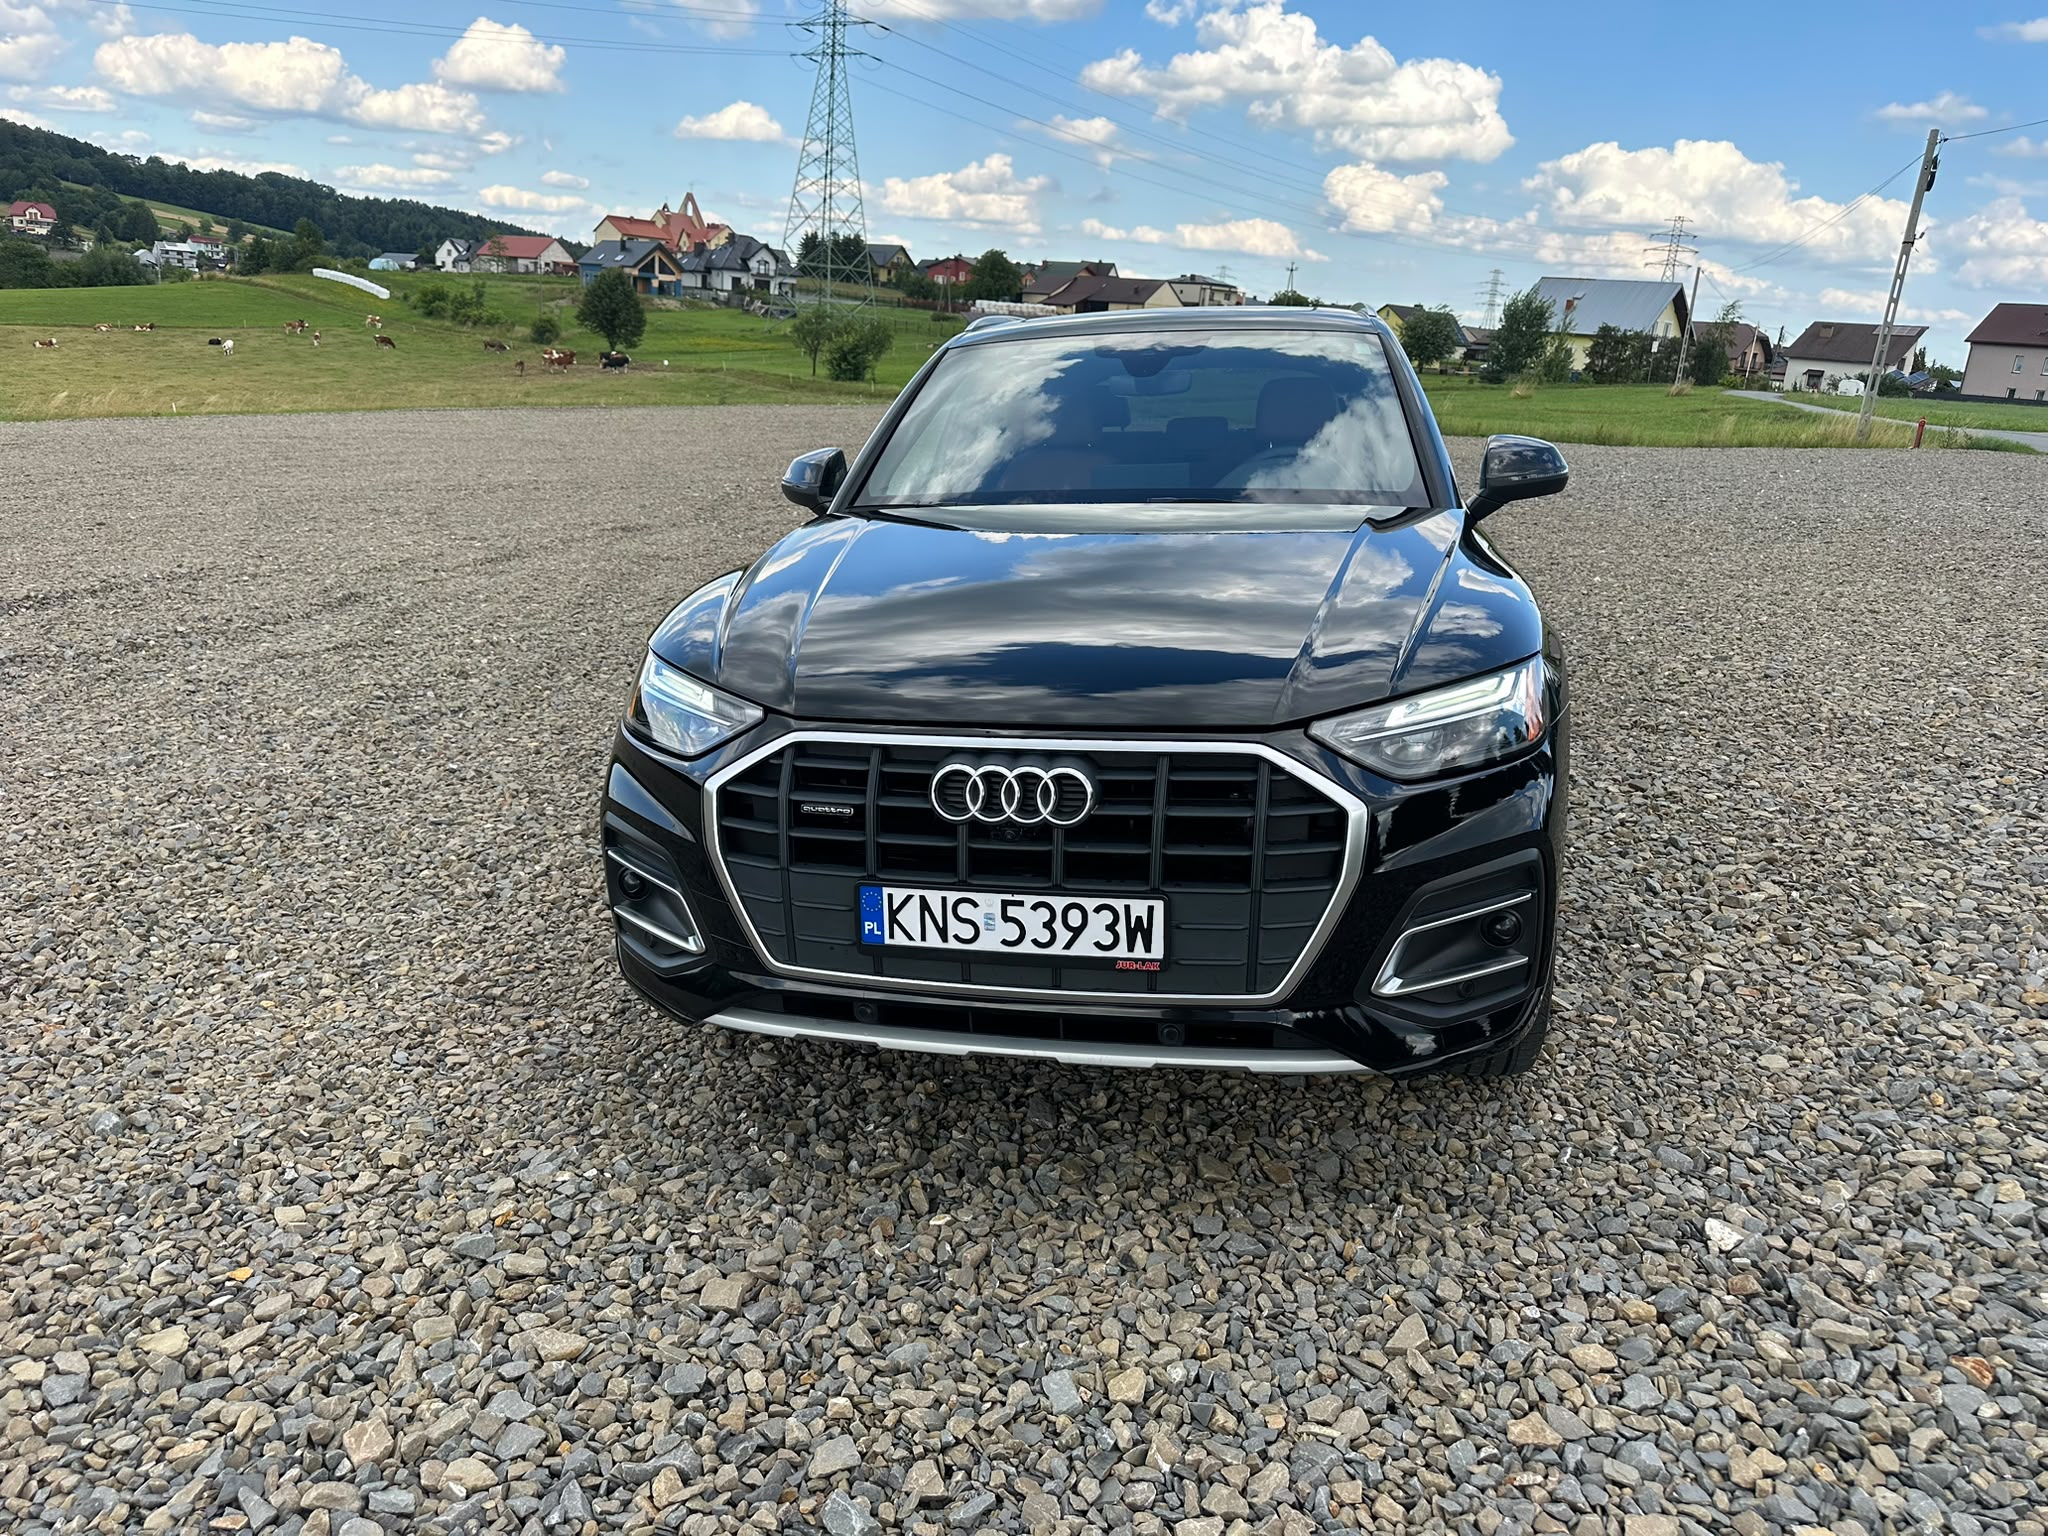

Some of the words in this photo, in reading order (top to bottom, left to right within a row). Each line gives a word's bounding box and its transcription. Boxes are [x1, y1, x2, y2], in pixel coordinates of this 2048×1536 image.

[802, 805, 851, 815] quattro
[864, 921, 881, 935] PL
[887, 892, 981, 944] KNS
[1000, 898, 1155, 953] 5393W
